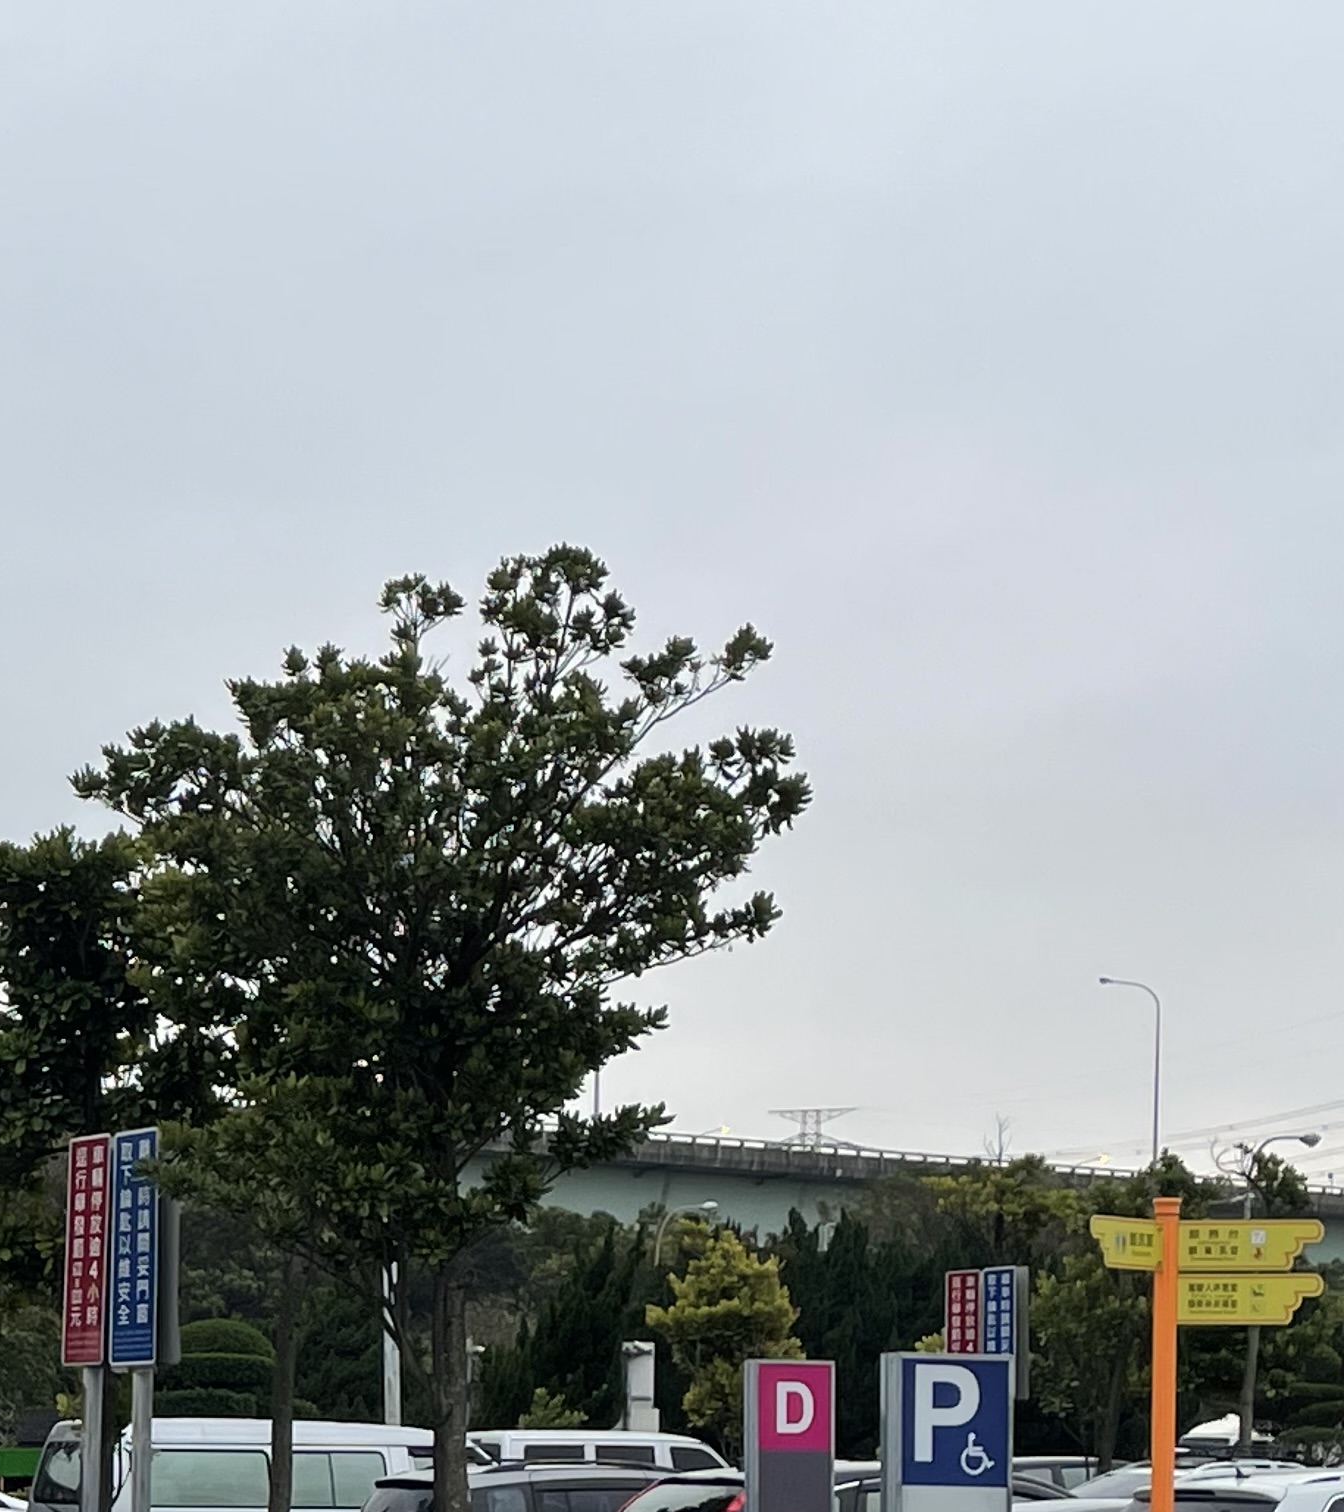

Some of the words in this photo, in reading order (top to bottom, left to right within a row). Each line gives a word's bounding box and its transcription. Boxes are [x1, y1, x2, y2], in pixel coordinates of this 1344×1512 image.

[136, 1139, 150, 1324] 離時請關妥門窗
[776, 1381, 815, 1434] D
[914, 1363, 980, 1463] P
